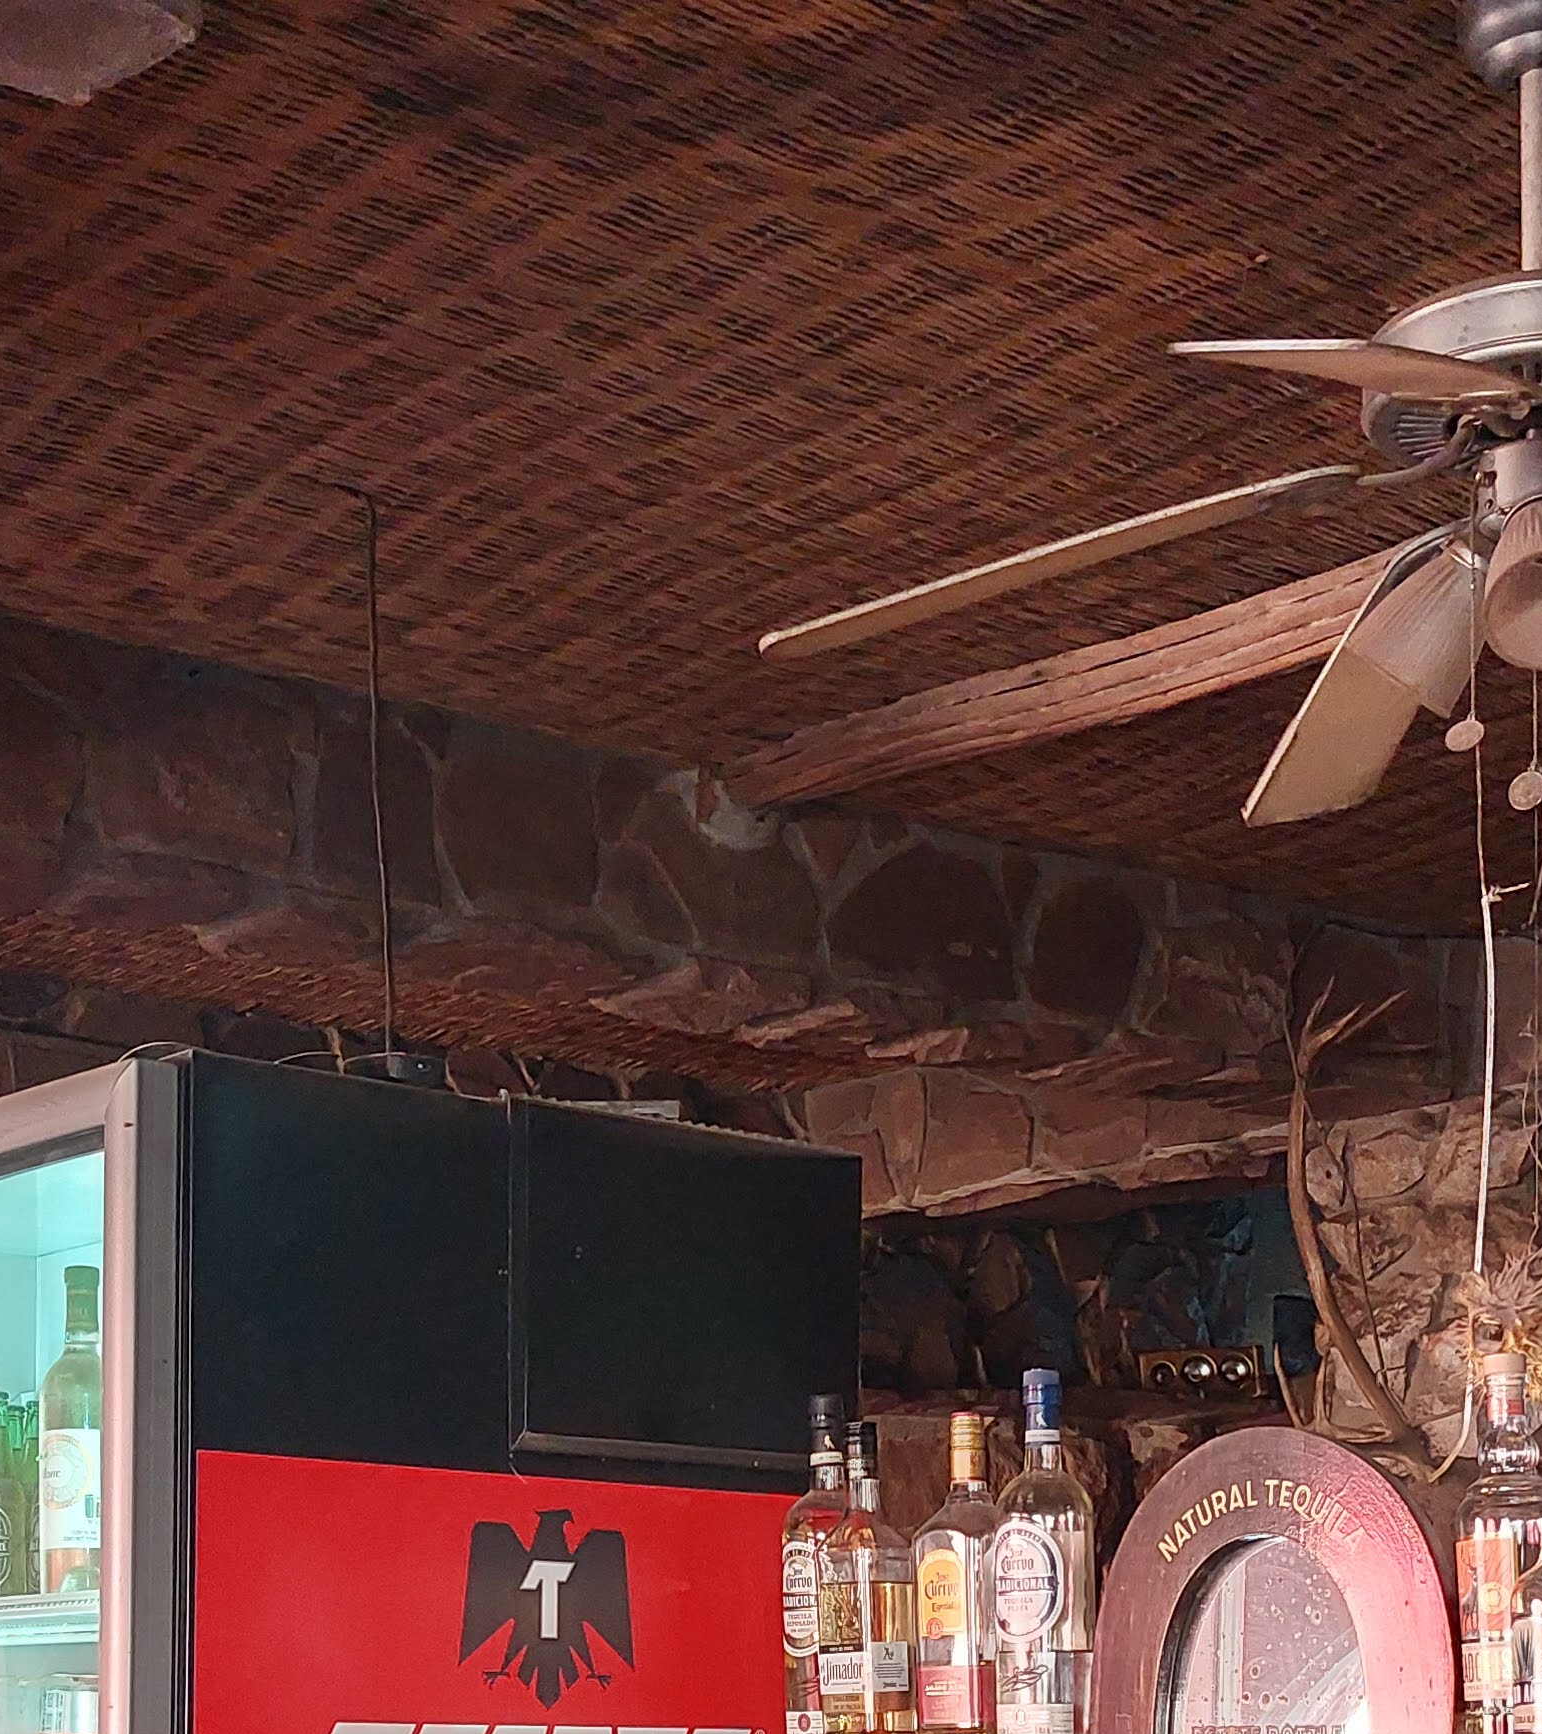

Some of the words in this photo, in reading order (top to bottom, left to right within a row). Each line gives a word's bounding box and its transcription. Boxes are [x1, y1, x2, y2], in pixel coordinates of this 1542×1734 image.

[1157, 1480, 1259, 1563] NATURAL
[1000, 1555, 1034, 1574] Cuervo
[785, 1576, 814, 1591] Cuervo
[822, 1657, 863, 1687] Jimador
